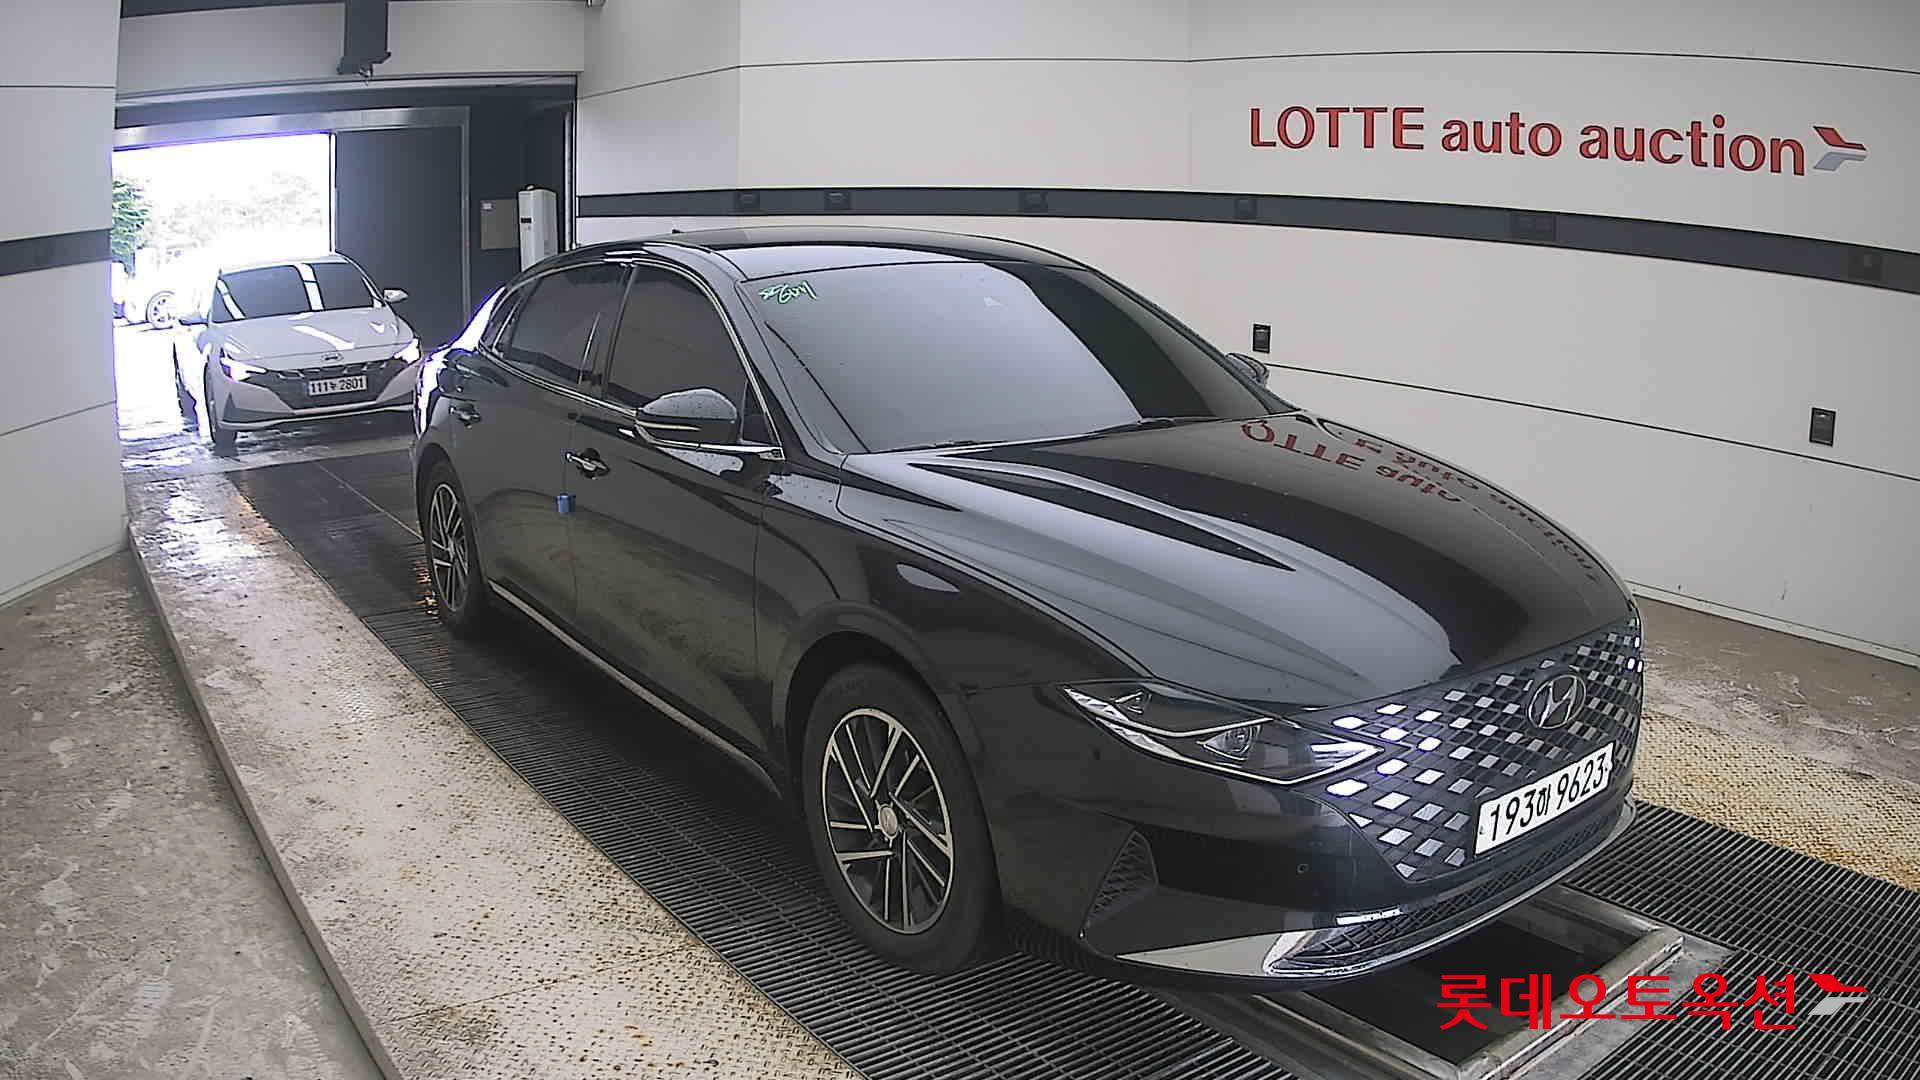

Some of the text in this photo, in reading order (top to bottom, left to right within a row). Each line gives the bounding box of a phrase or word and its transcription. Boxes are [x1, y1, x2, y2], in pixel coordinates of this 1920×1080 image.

[1250, 105, 1806, 177] LOTTE auto auction
[338, 378, 364, 390] 2801
[1490, 752, 1607, 842] 193하 9623
